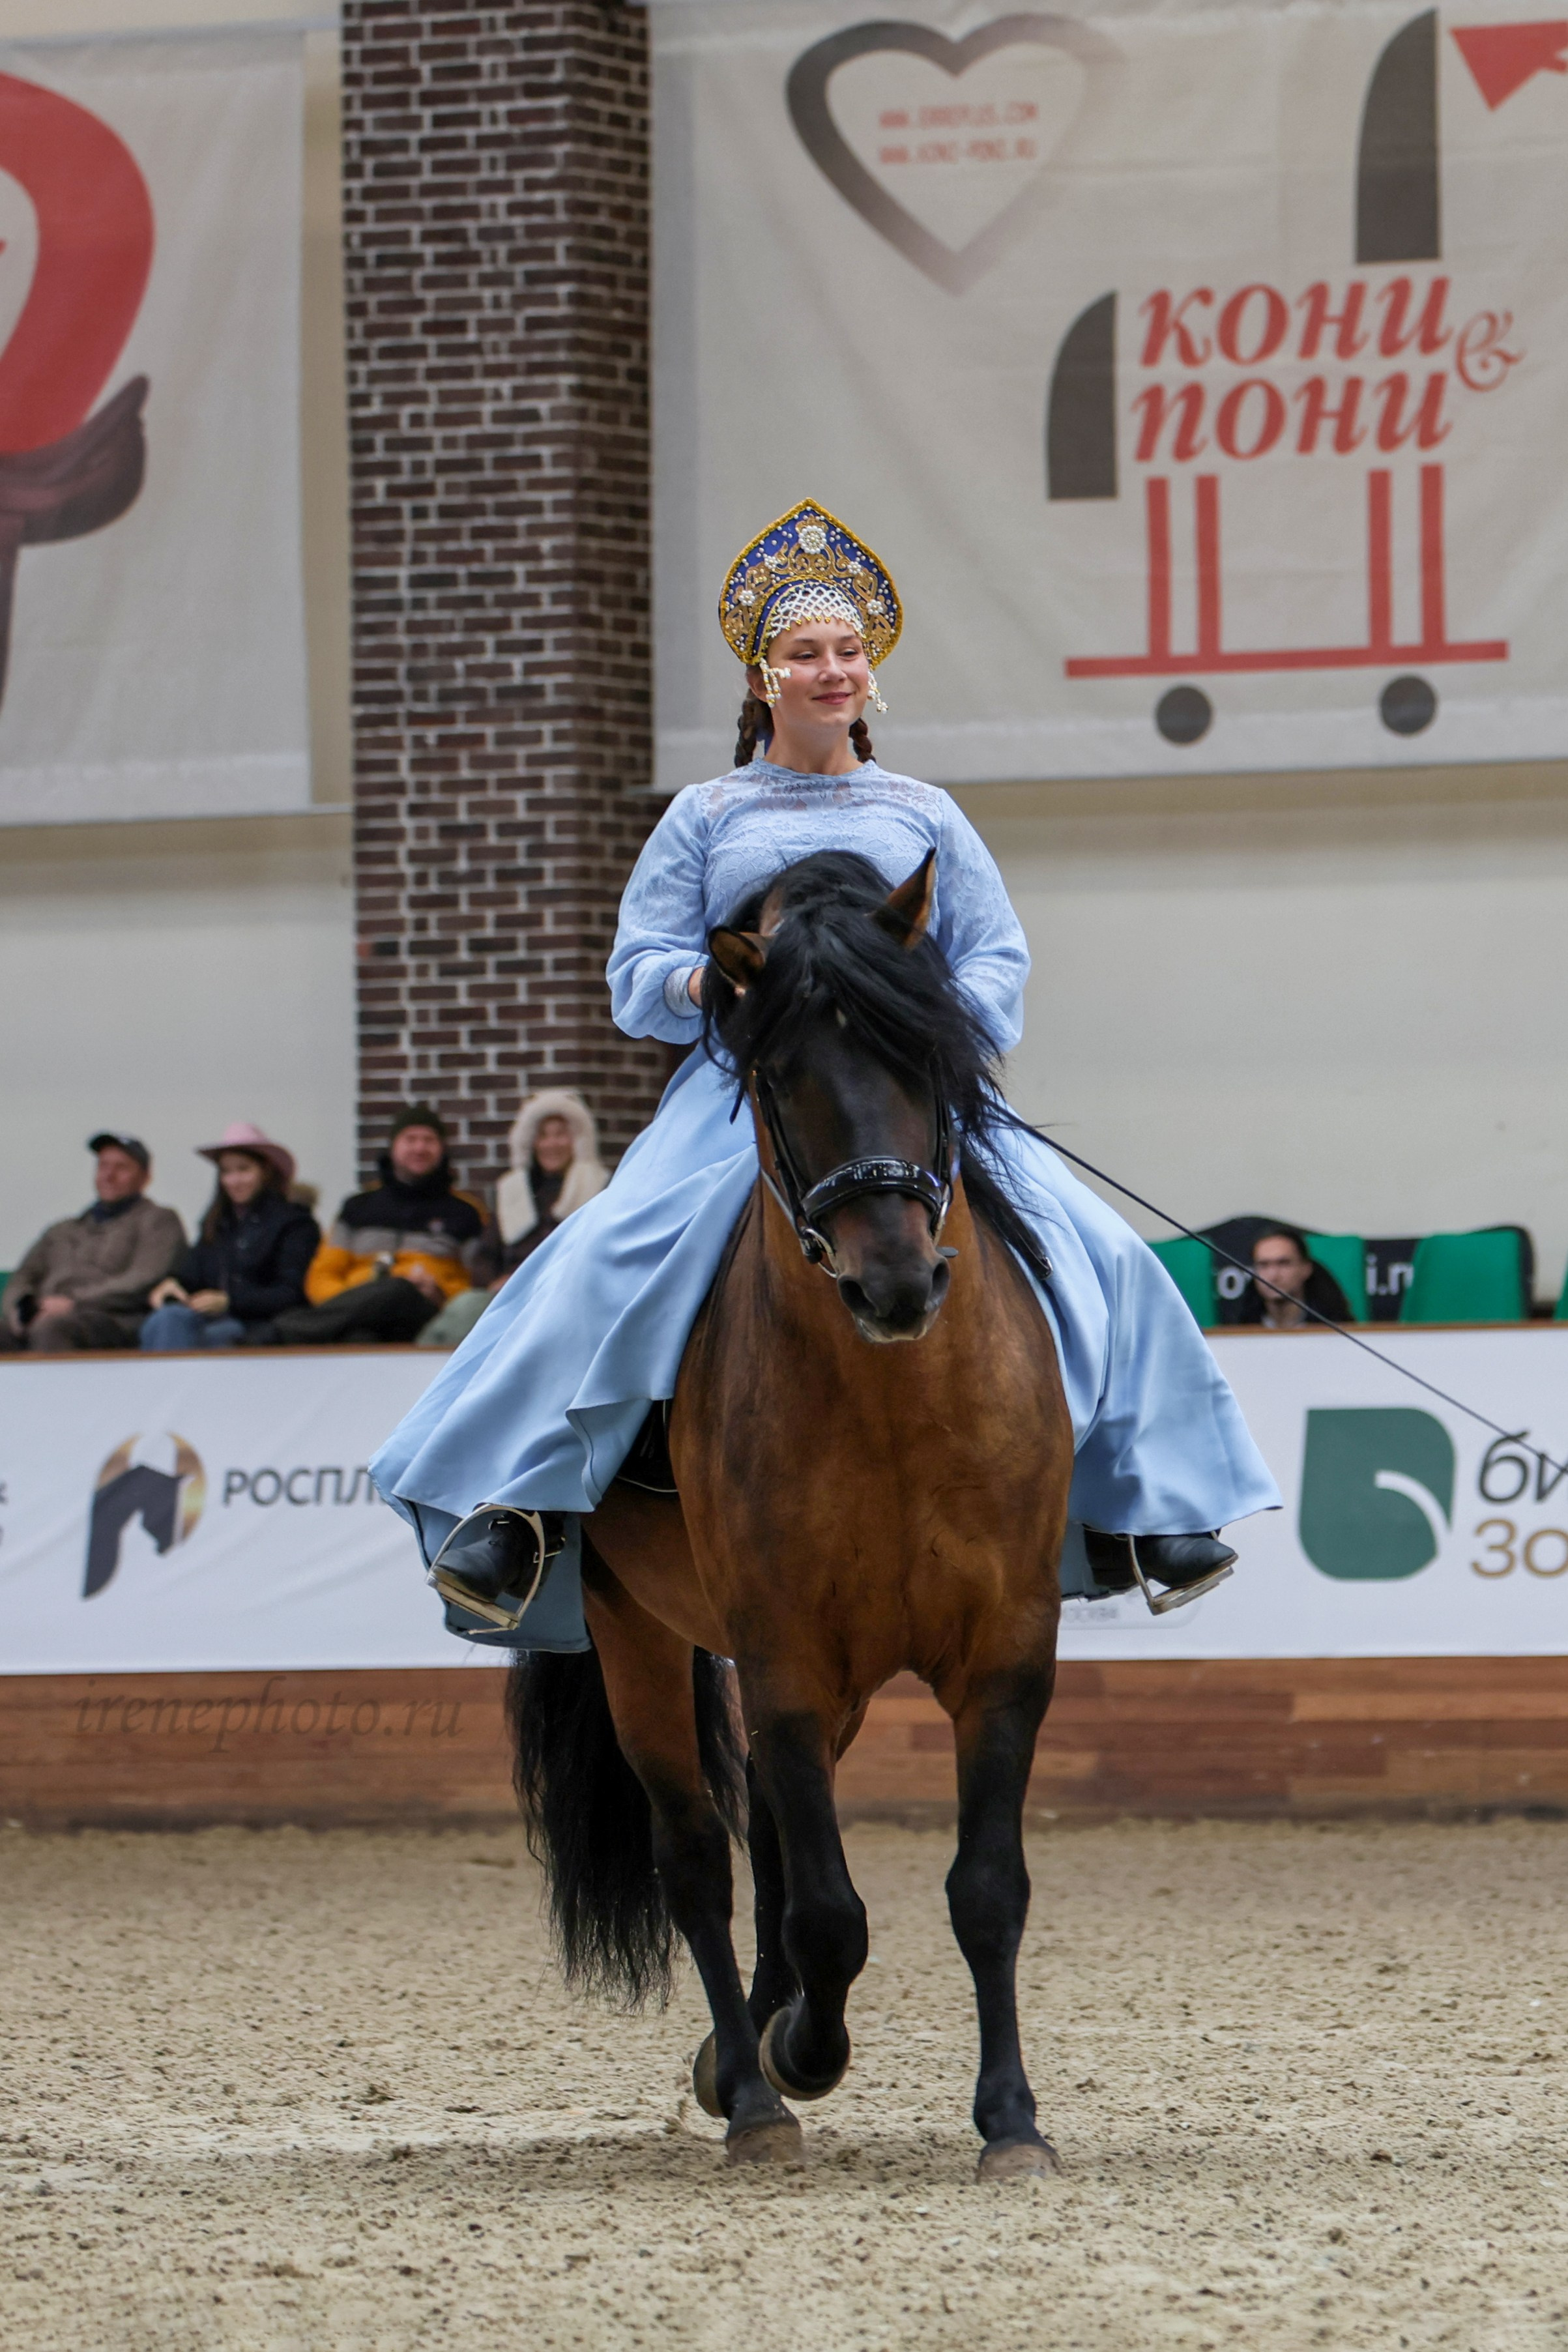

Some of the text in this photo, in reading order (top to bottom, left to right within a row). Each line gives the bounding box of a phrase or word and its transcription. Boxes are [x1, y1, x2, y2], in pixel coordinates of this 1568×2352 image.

[1139, 276, 1453, 368] кони
[1130, 371, 1452, 462] пони
[223, 1466, 392, 1508] РОСПЛ
